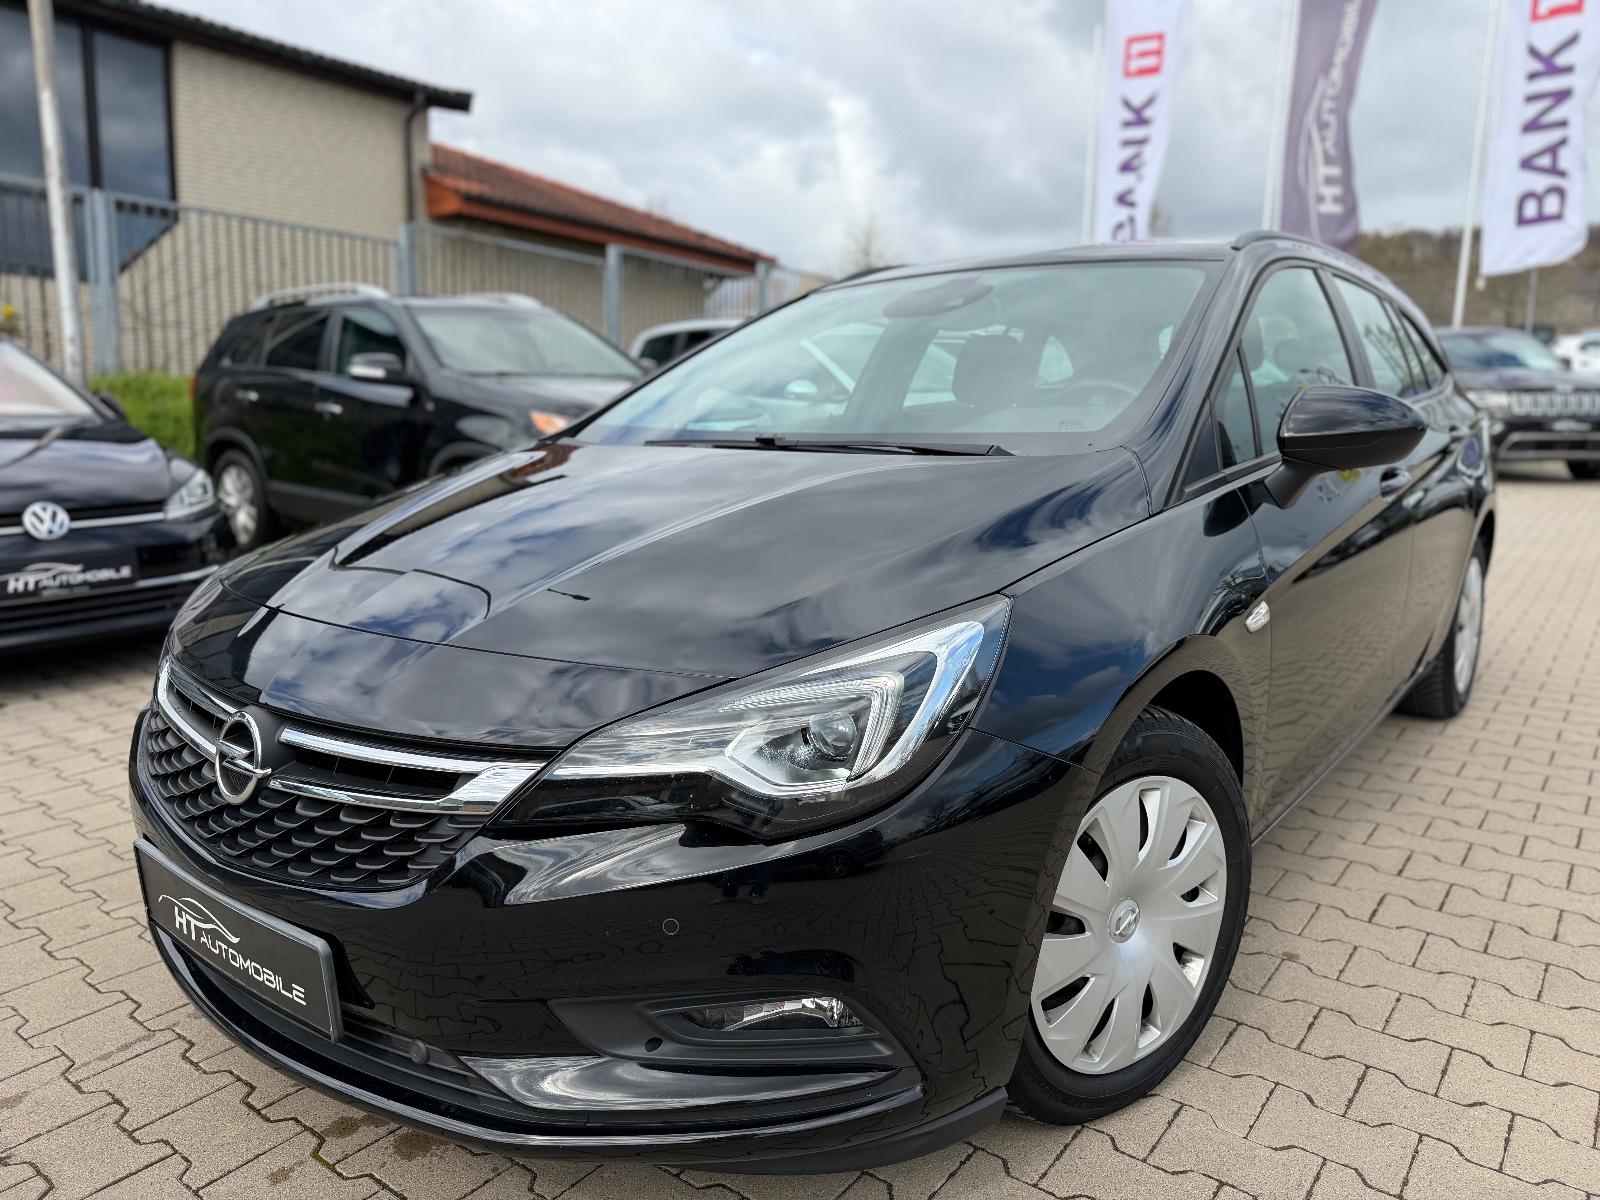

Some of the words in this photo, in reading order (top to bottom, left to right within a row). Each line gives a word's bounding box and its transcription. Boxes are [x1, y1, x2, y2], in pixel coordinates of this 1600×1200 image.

[1320, 0, 1363, 156] AUTOMOBIL
[1516, 30, 1582, 227] BANK
[1317, 165, 1344, 215] HT
[6, 576, 35, 594] HT
[174, 905, 201, 941] HT
[200, 931, 307, 1006] AUTOMOBILE
